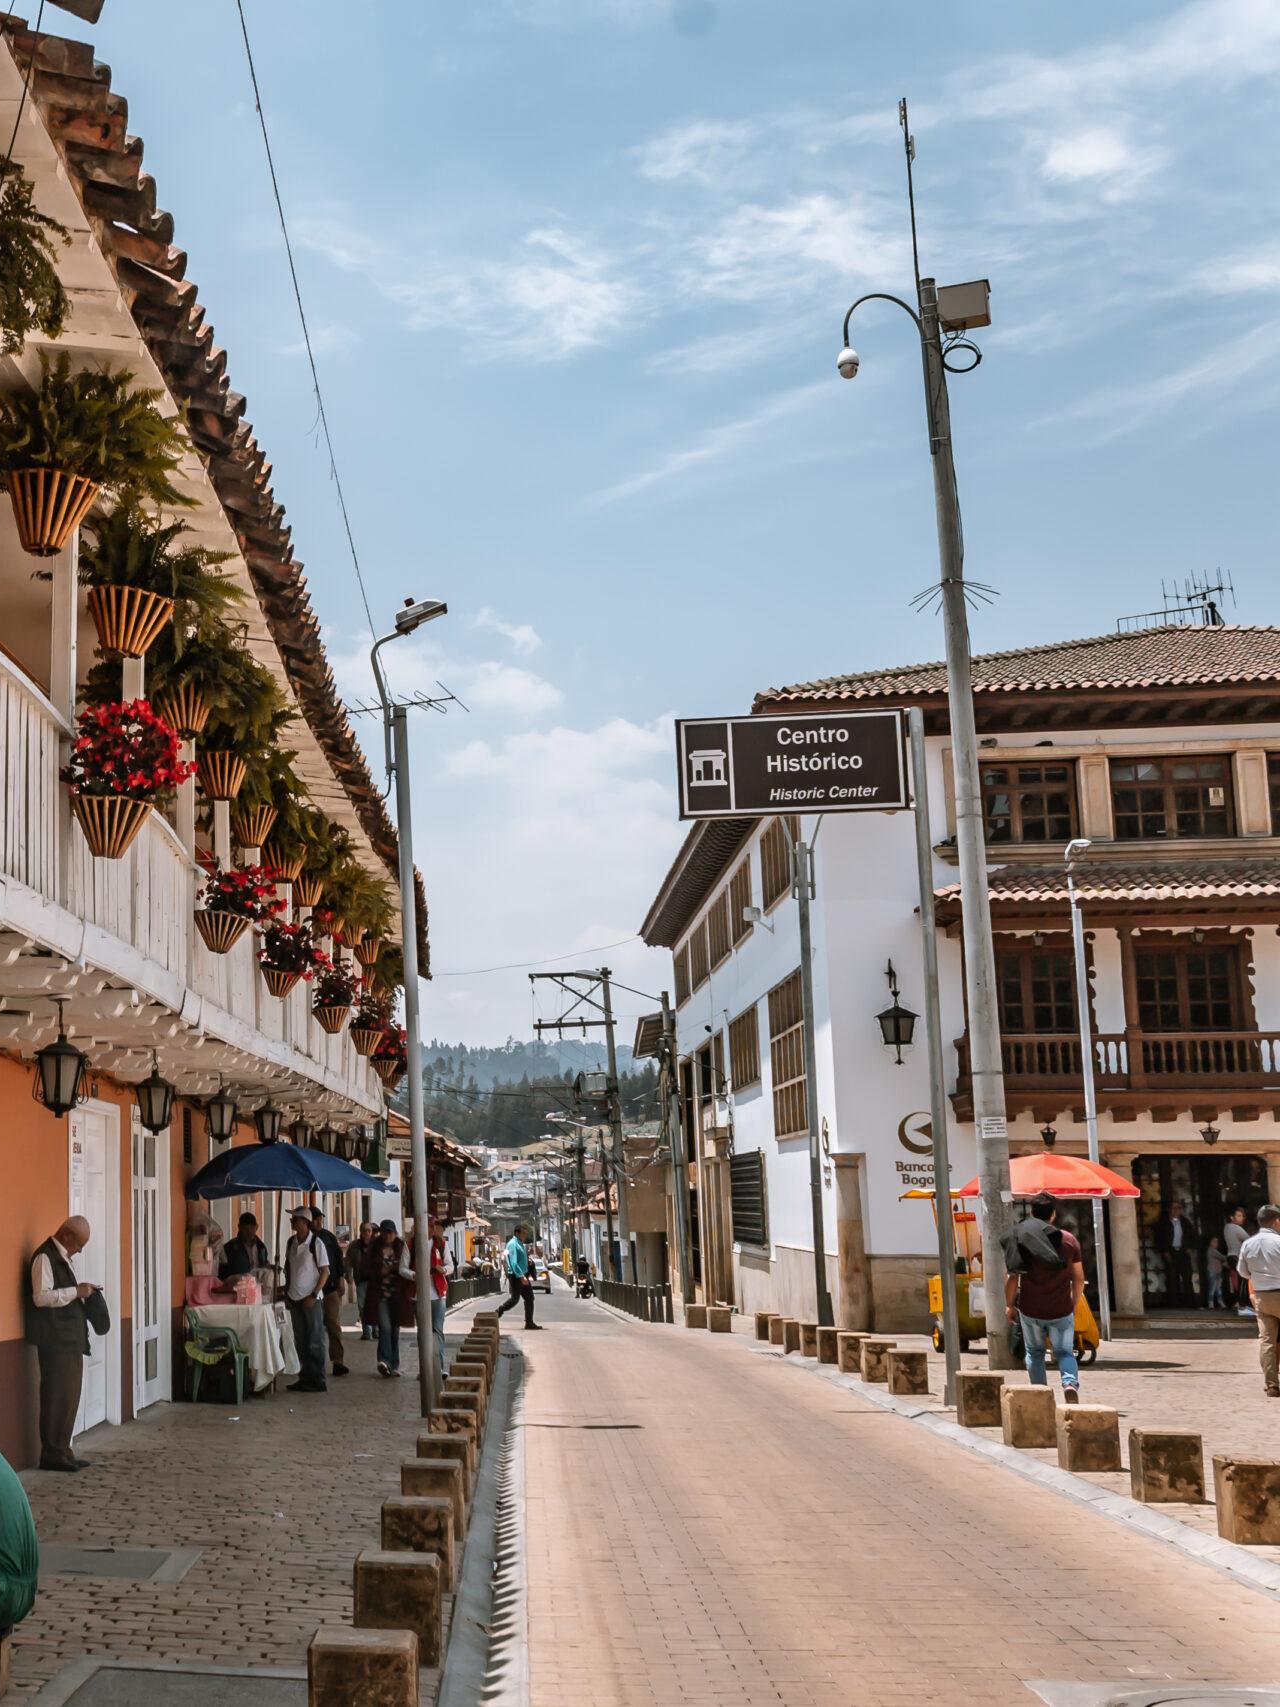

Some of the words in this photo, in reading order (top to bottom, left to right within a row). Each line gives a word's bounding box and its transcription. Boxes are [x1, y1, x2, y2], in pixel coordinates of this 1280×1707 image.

[777, 727, 849, 745] Centro
[767, 753, 863, 773] Histórico
[769, 787, 825, 801] Historic
[829, 785, 878, 798] Center
[895, 1161, 935, 1172] Banco
[901, 1174, 935, 1187] Bogo
